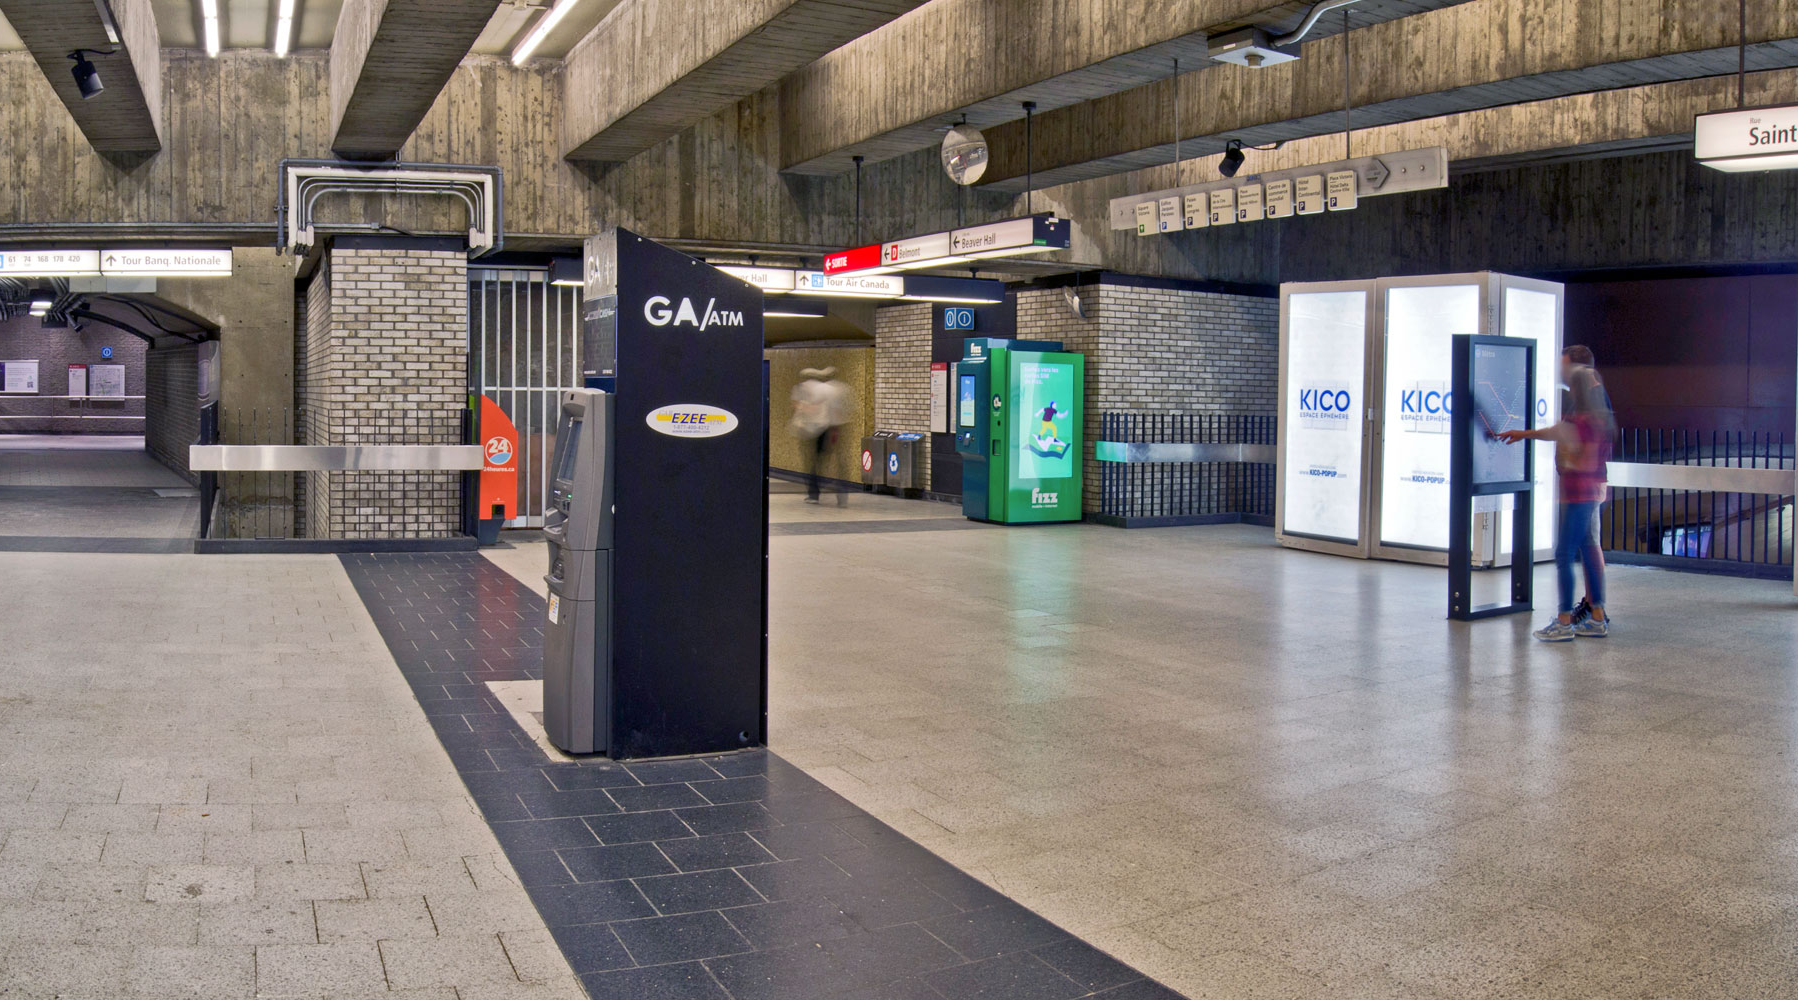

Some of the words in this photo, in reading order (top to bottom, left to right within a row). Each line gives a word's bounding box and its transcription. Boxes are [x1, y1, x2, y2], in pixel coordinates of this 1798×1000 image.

[1749, 124, 1798, 146] Saint
[962, 237, 983, 249] Beaver
[983, 233, 996, 245] Hall
[8, 255, 16, 263] 61
[24, 255, 32, 263] 74
[37, 255, 49, 263] 168
[53, 255, 64, 263] 178
[68, 255, 81, 263] 420
[892, 249, 899, 259] D
[898, 246, 921, 258] Belmont
[121, 255, 142, 265] Tour
[145, 255, 172, 268] Banq.
[174, 255, 221, 265] Nationale
[831, 256, 848, 269] SORTIE
[751, 274, 768, 283] Hall
[826, 277, 843, 287] Tour
[845, 278, 858, 288] Air
[859, 279, 890, 290] Canada
[1300, 389, 1351, 412] KICO
[671, 412, 708, 425] EZEE
[1400, 414, 1424, 422] ESPACE
[488, 439, 509, 454] 24
[1031, 487, 1059, 504] fizz
